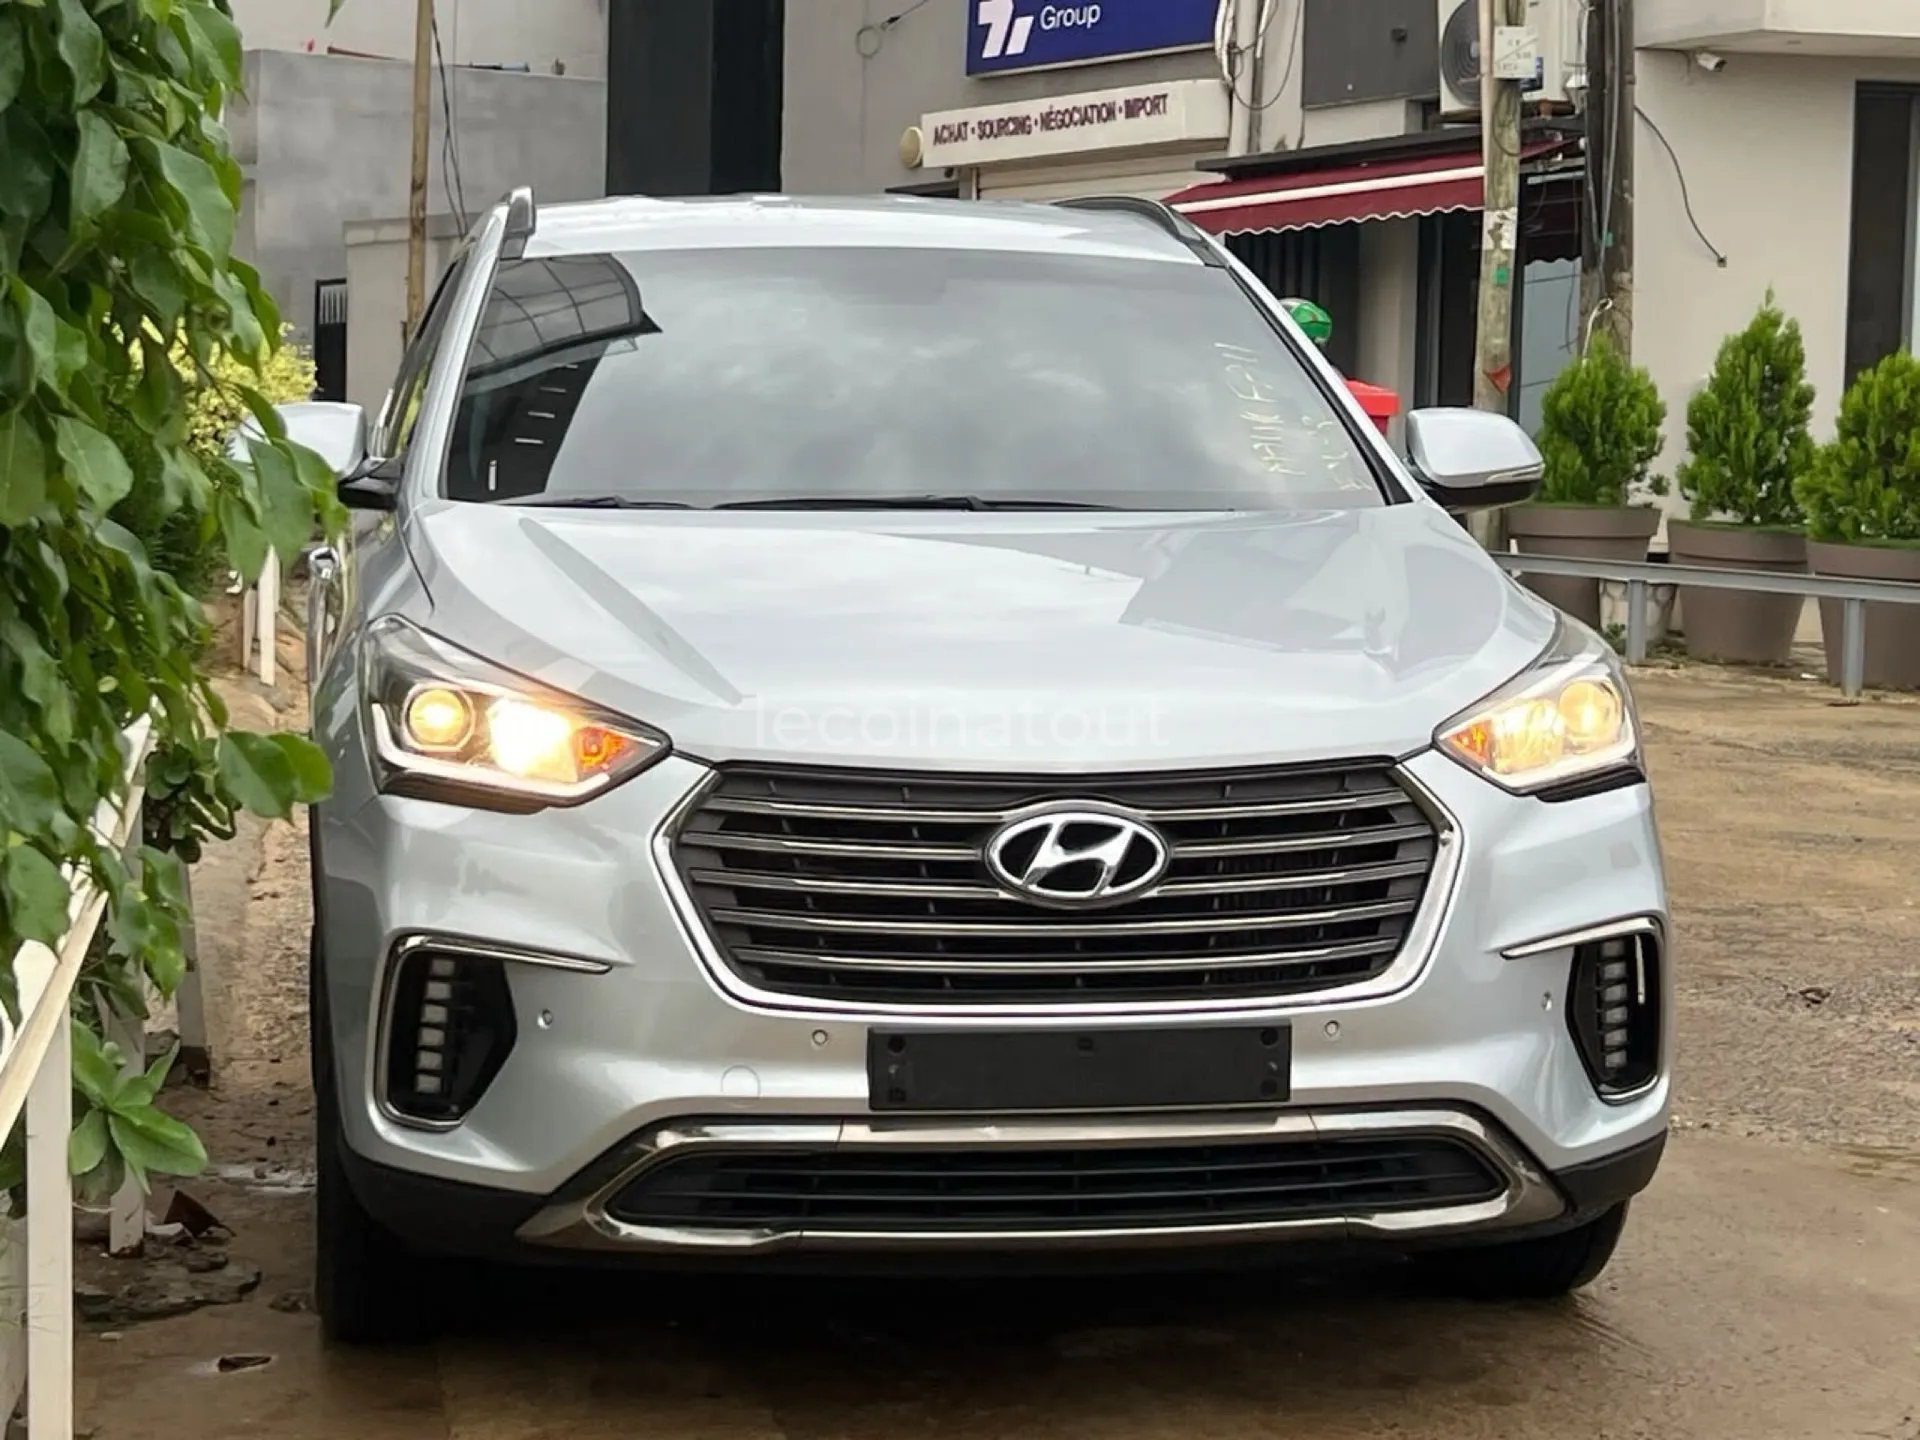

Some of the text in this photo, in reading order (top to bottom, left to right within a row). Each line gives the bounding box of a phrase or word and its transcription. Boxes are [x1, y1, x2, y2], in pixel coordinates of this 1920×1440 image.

[1040, 4, 1100, 30] Group
[933, 121, 968, 146] ACHAT
[977, 114, 1032, 140] SOURCING
[1123, 93, 1168, 120] IMPORT
